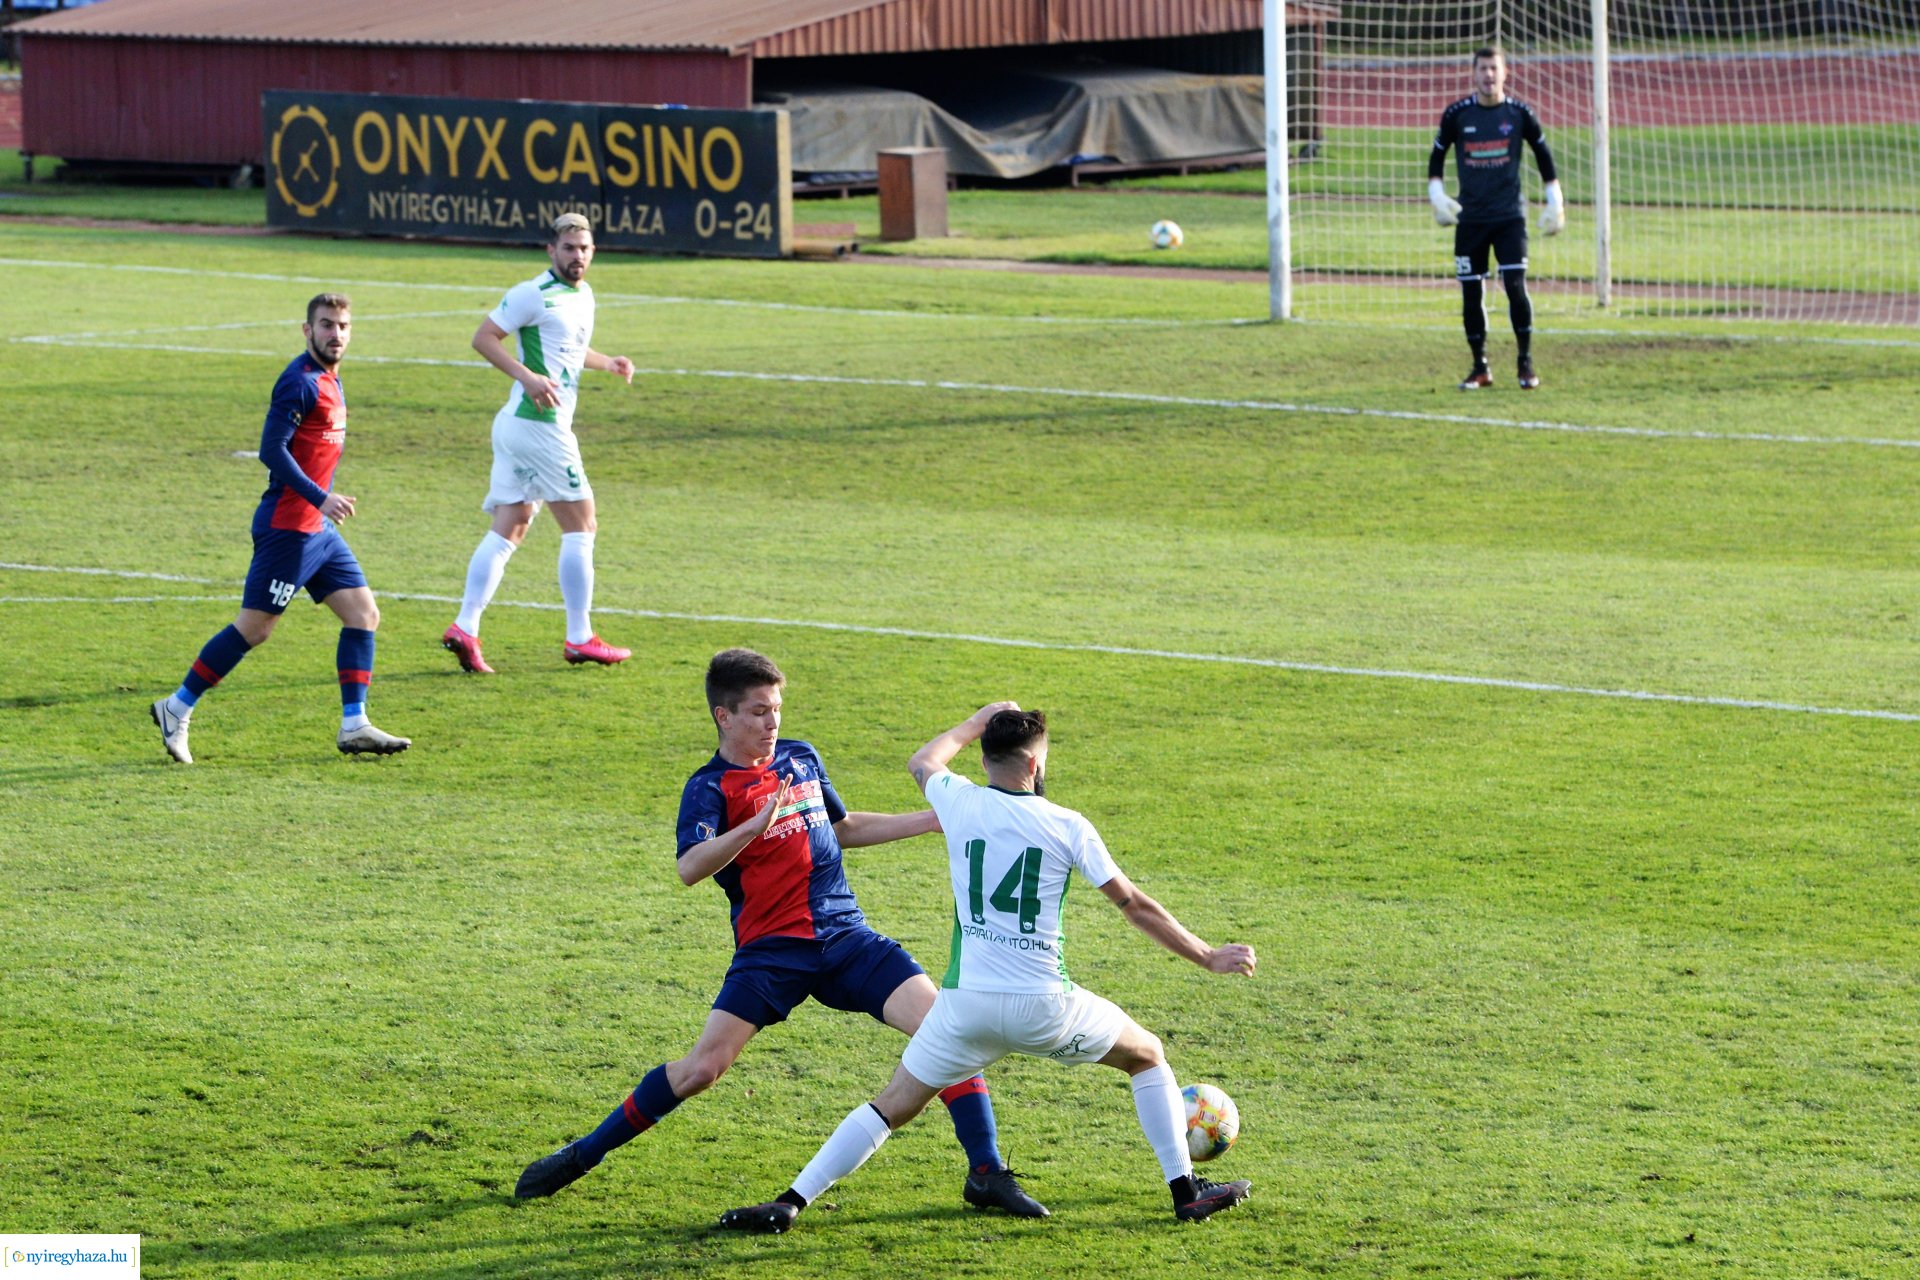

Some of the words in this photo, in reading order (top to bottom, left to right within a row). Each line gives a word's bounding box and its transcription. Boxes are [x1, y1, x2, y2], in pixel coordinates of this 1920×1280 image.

[352, 111, 511, 181] ONYX
[523, 119, 744, 193] CASINO
[695, 198, 774, 241] 0-24
[268, 578, 296, 607] 48
[964, 838, 1043, 935] 14
